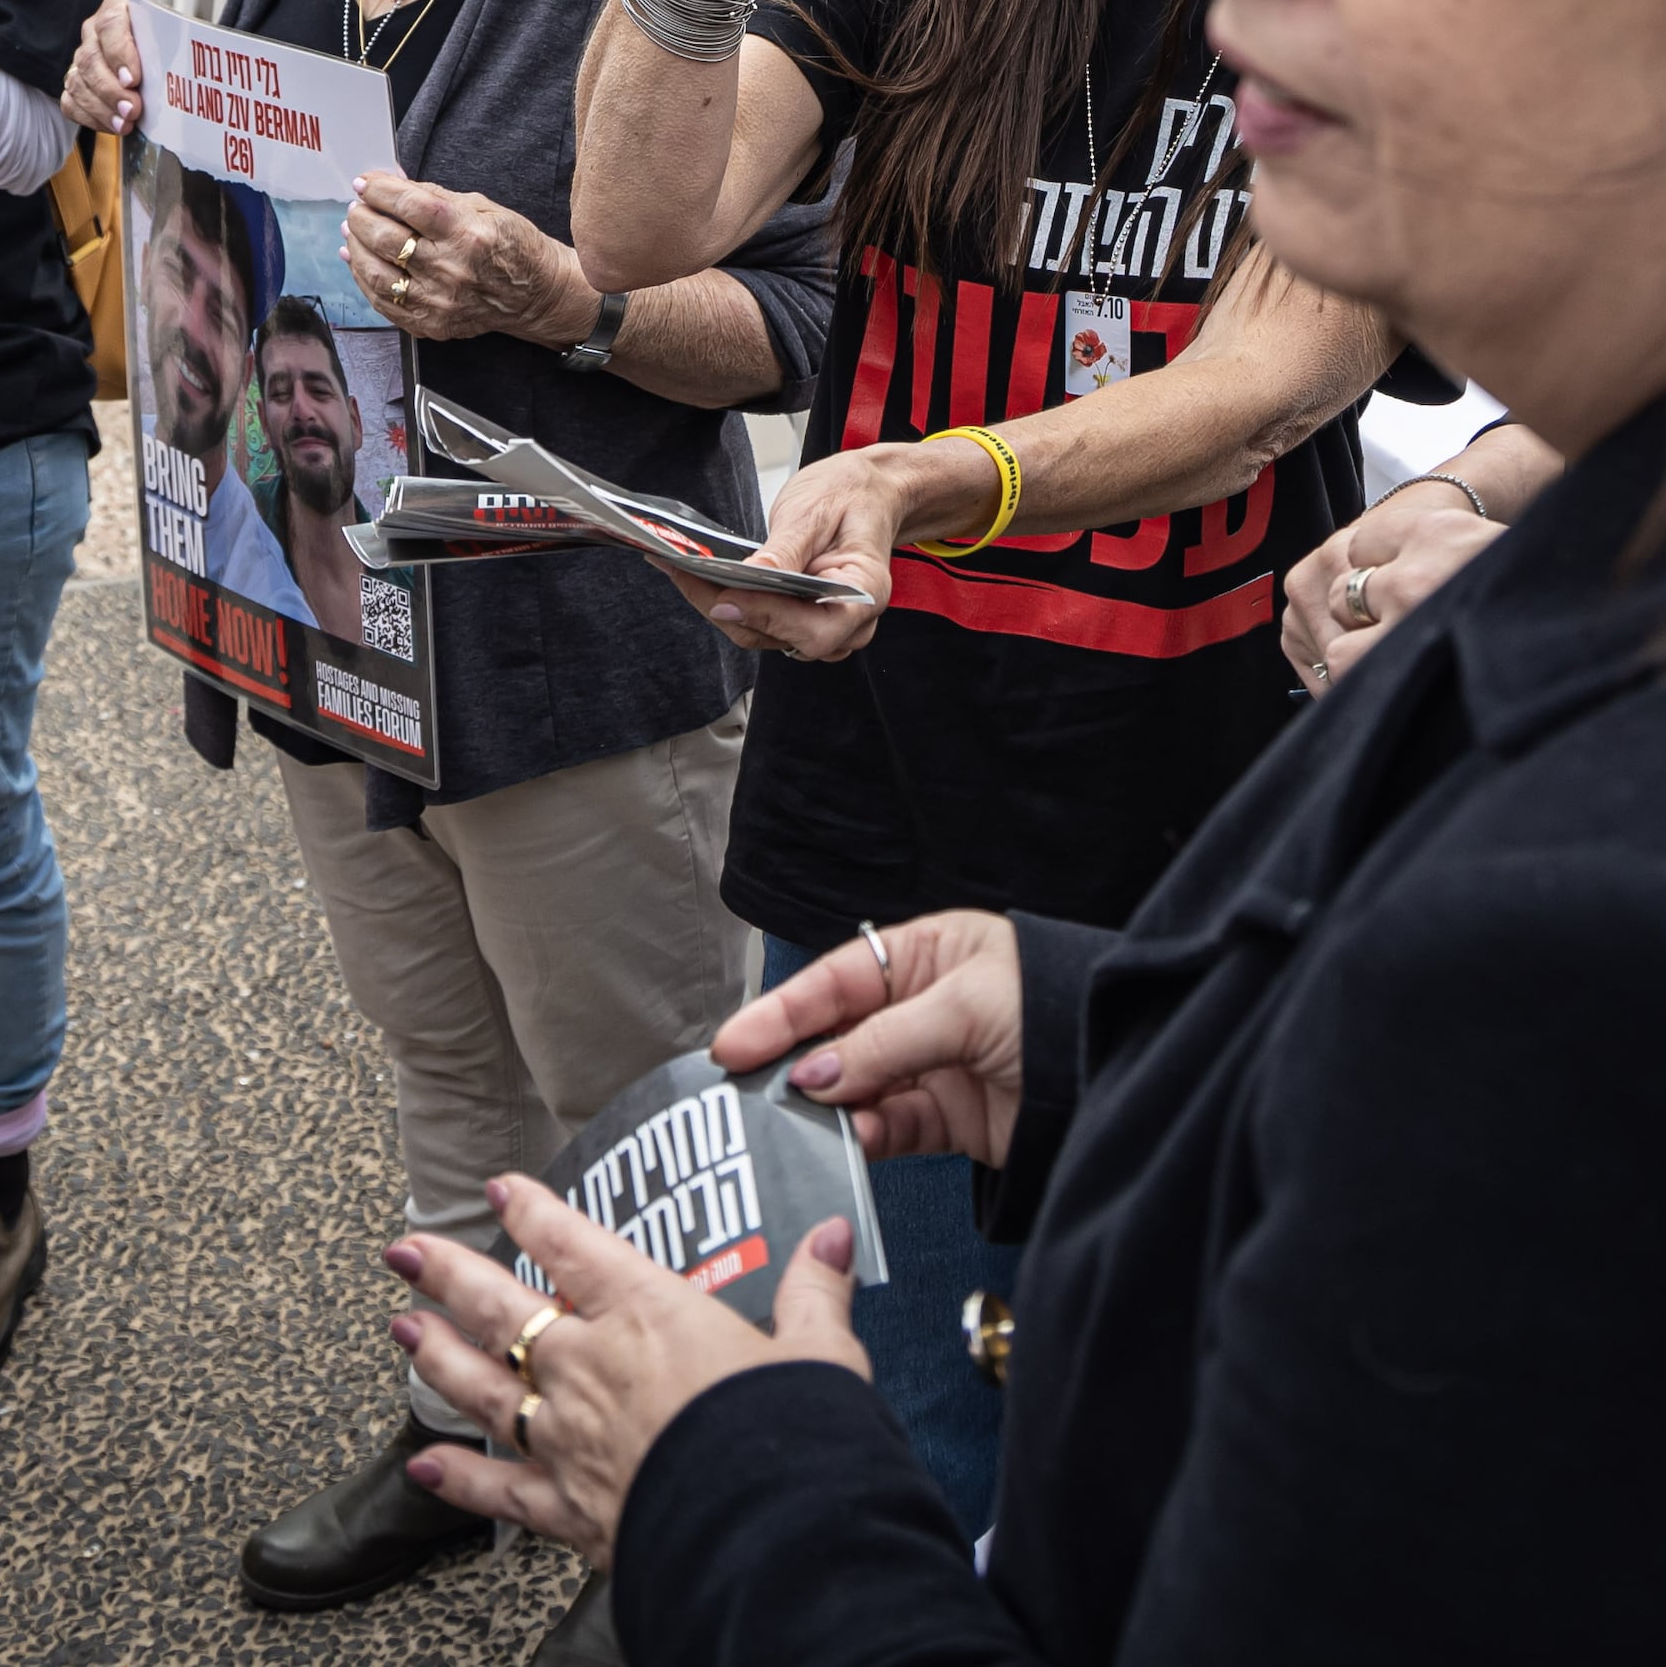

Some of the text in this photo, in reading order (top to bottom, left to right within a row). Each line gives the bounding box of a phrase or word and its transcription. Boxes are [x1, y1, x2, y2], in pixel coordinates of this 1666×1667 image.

[191, 39, 281, 99] גלי וזיו ברמן
[166, 72, 322, 152] GALI AND ZIV BERMAN
[224, 131, 254, 179] (26)
[142, 431, 208, 518] BRING
[145, 494, 206, 578] THEM
[150, 563, 289, 684] HOME NOW!
[315, 660, 421, 721] HOSTAGES AND MISSING
[317, 681, 422, 750] FAMILIES FORUM
[583, 1082, 747, 1237] מחזירים
